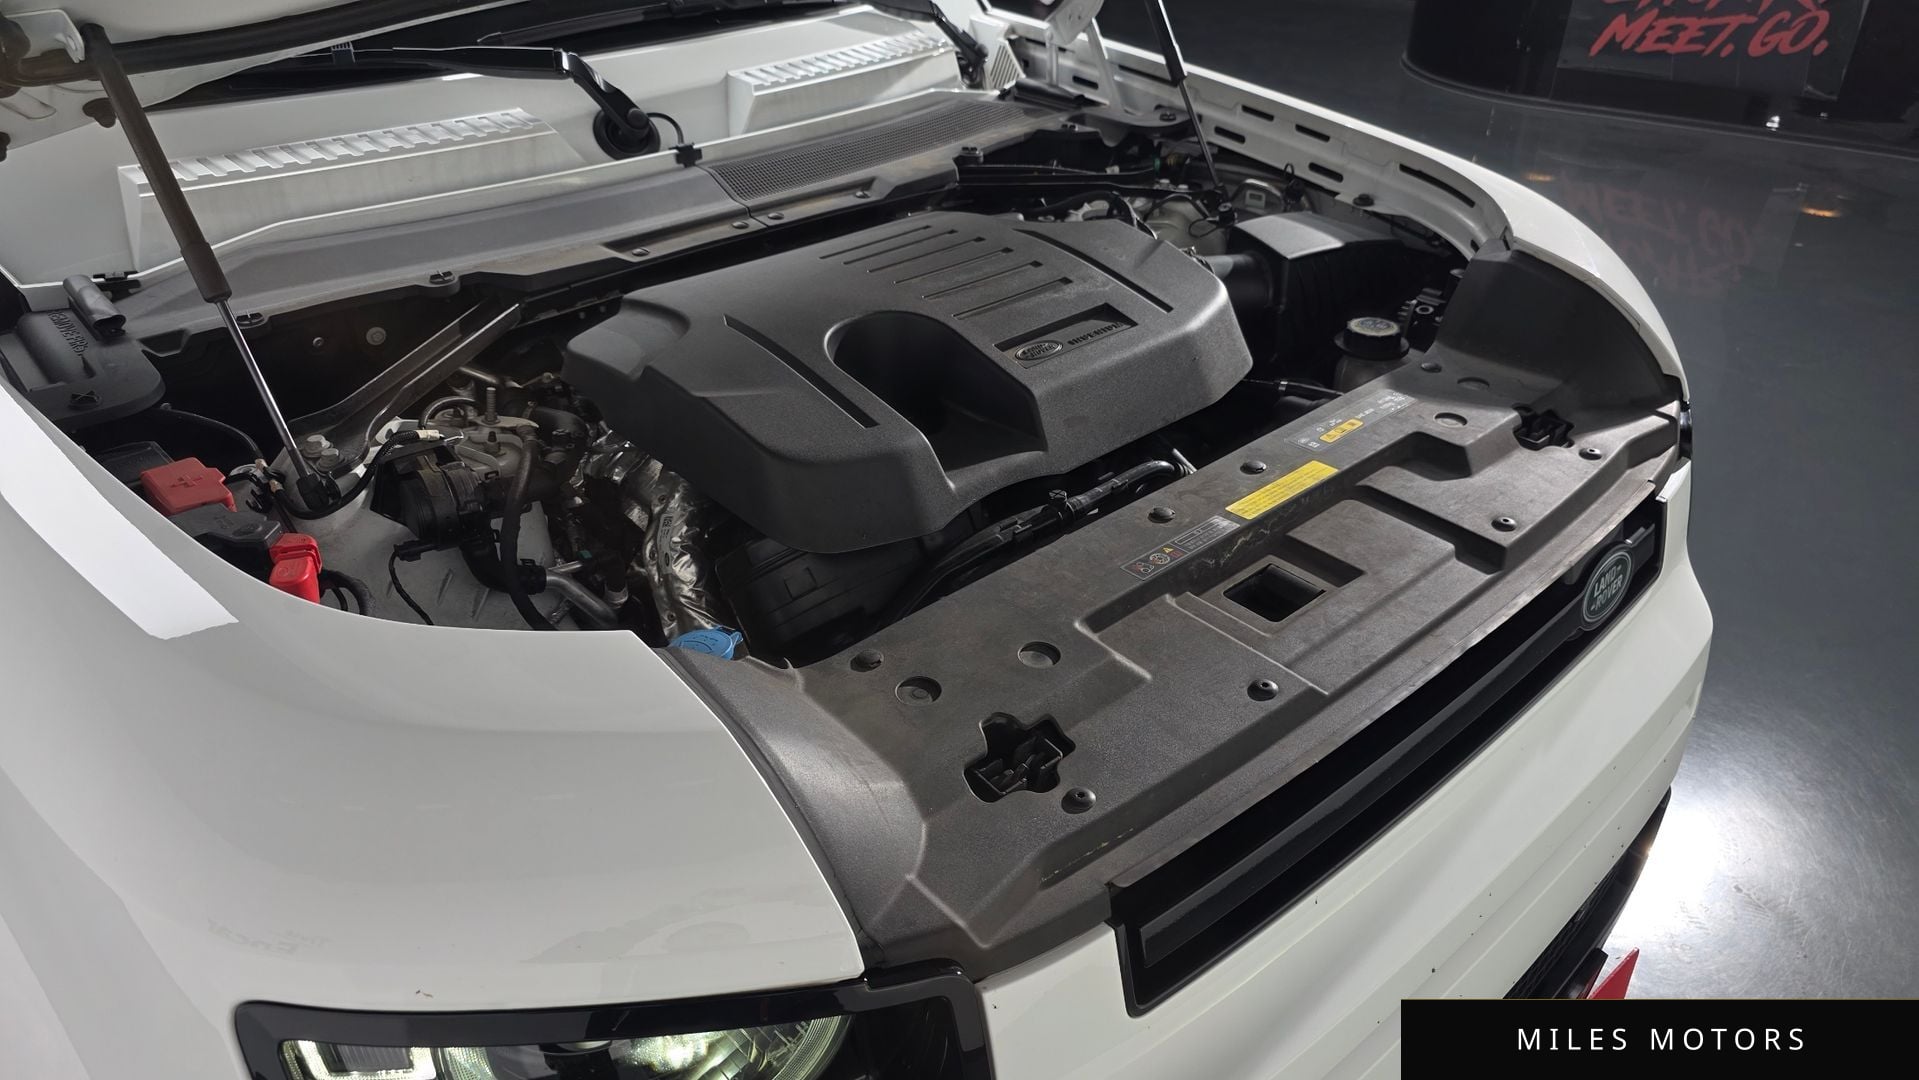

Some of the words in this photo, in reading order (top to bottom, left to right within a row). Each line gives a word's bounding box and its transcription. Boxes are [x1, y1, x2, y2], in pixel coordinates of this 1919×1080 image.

[1589, 8, 1757, 57] MEET.
[1748, 10, 1829, 57] GO.
[1594, 566, 1617, 597] LAND
[1595, 574, 1623, 610] ROVER
